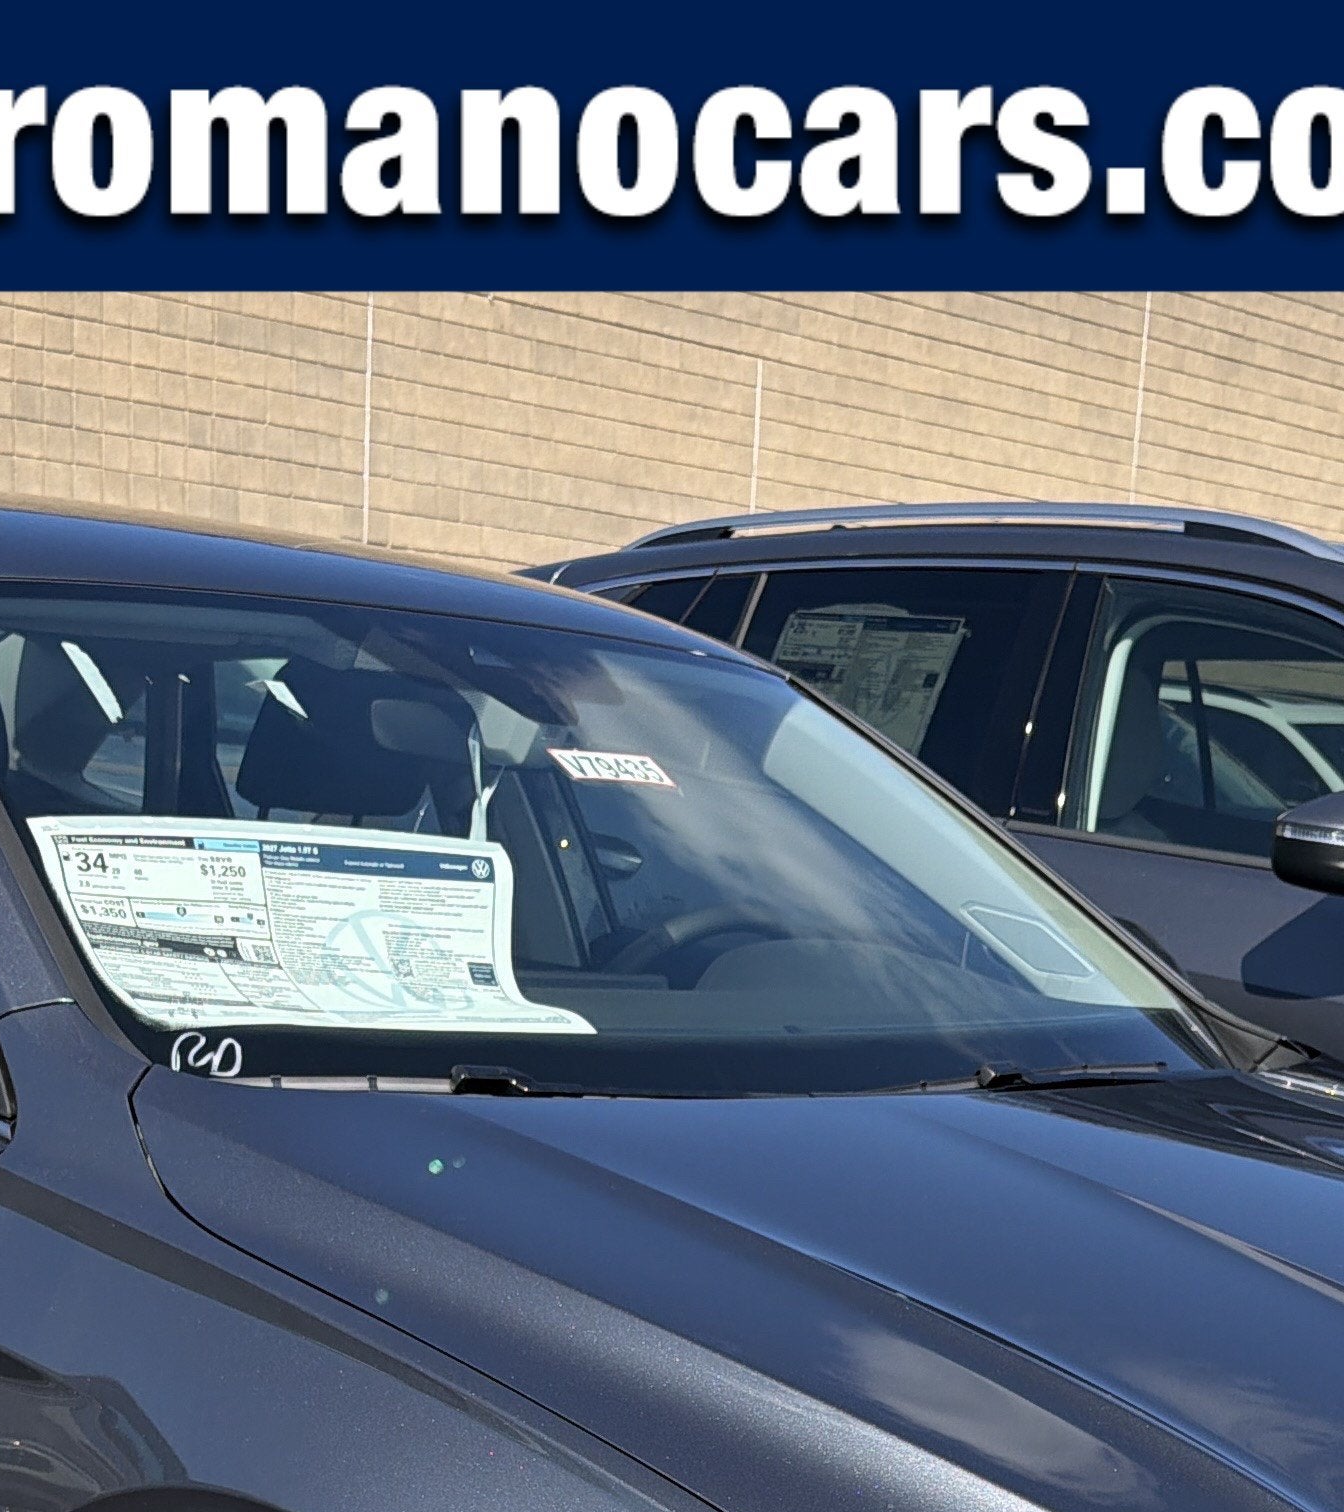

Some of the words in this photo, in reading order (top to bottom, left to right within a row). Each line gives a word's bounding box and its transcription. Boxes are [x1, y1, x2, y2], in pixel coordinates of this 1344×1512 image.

[558, 754, 665, 782] V79435
[74, 851, 109, 873] 34
[200, 863, 247, 879] $1,250
[80, 904, 127, 919] $1,350
